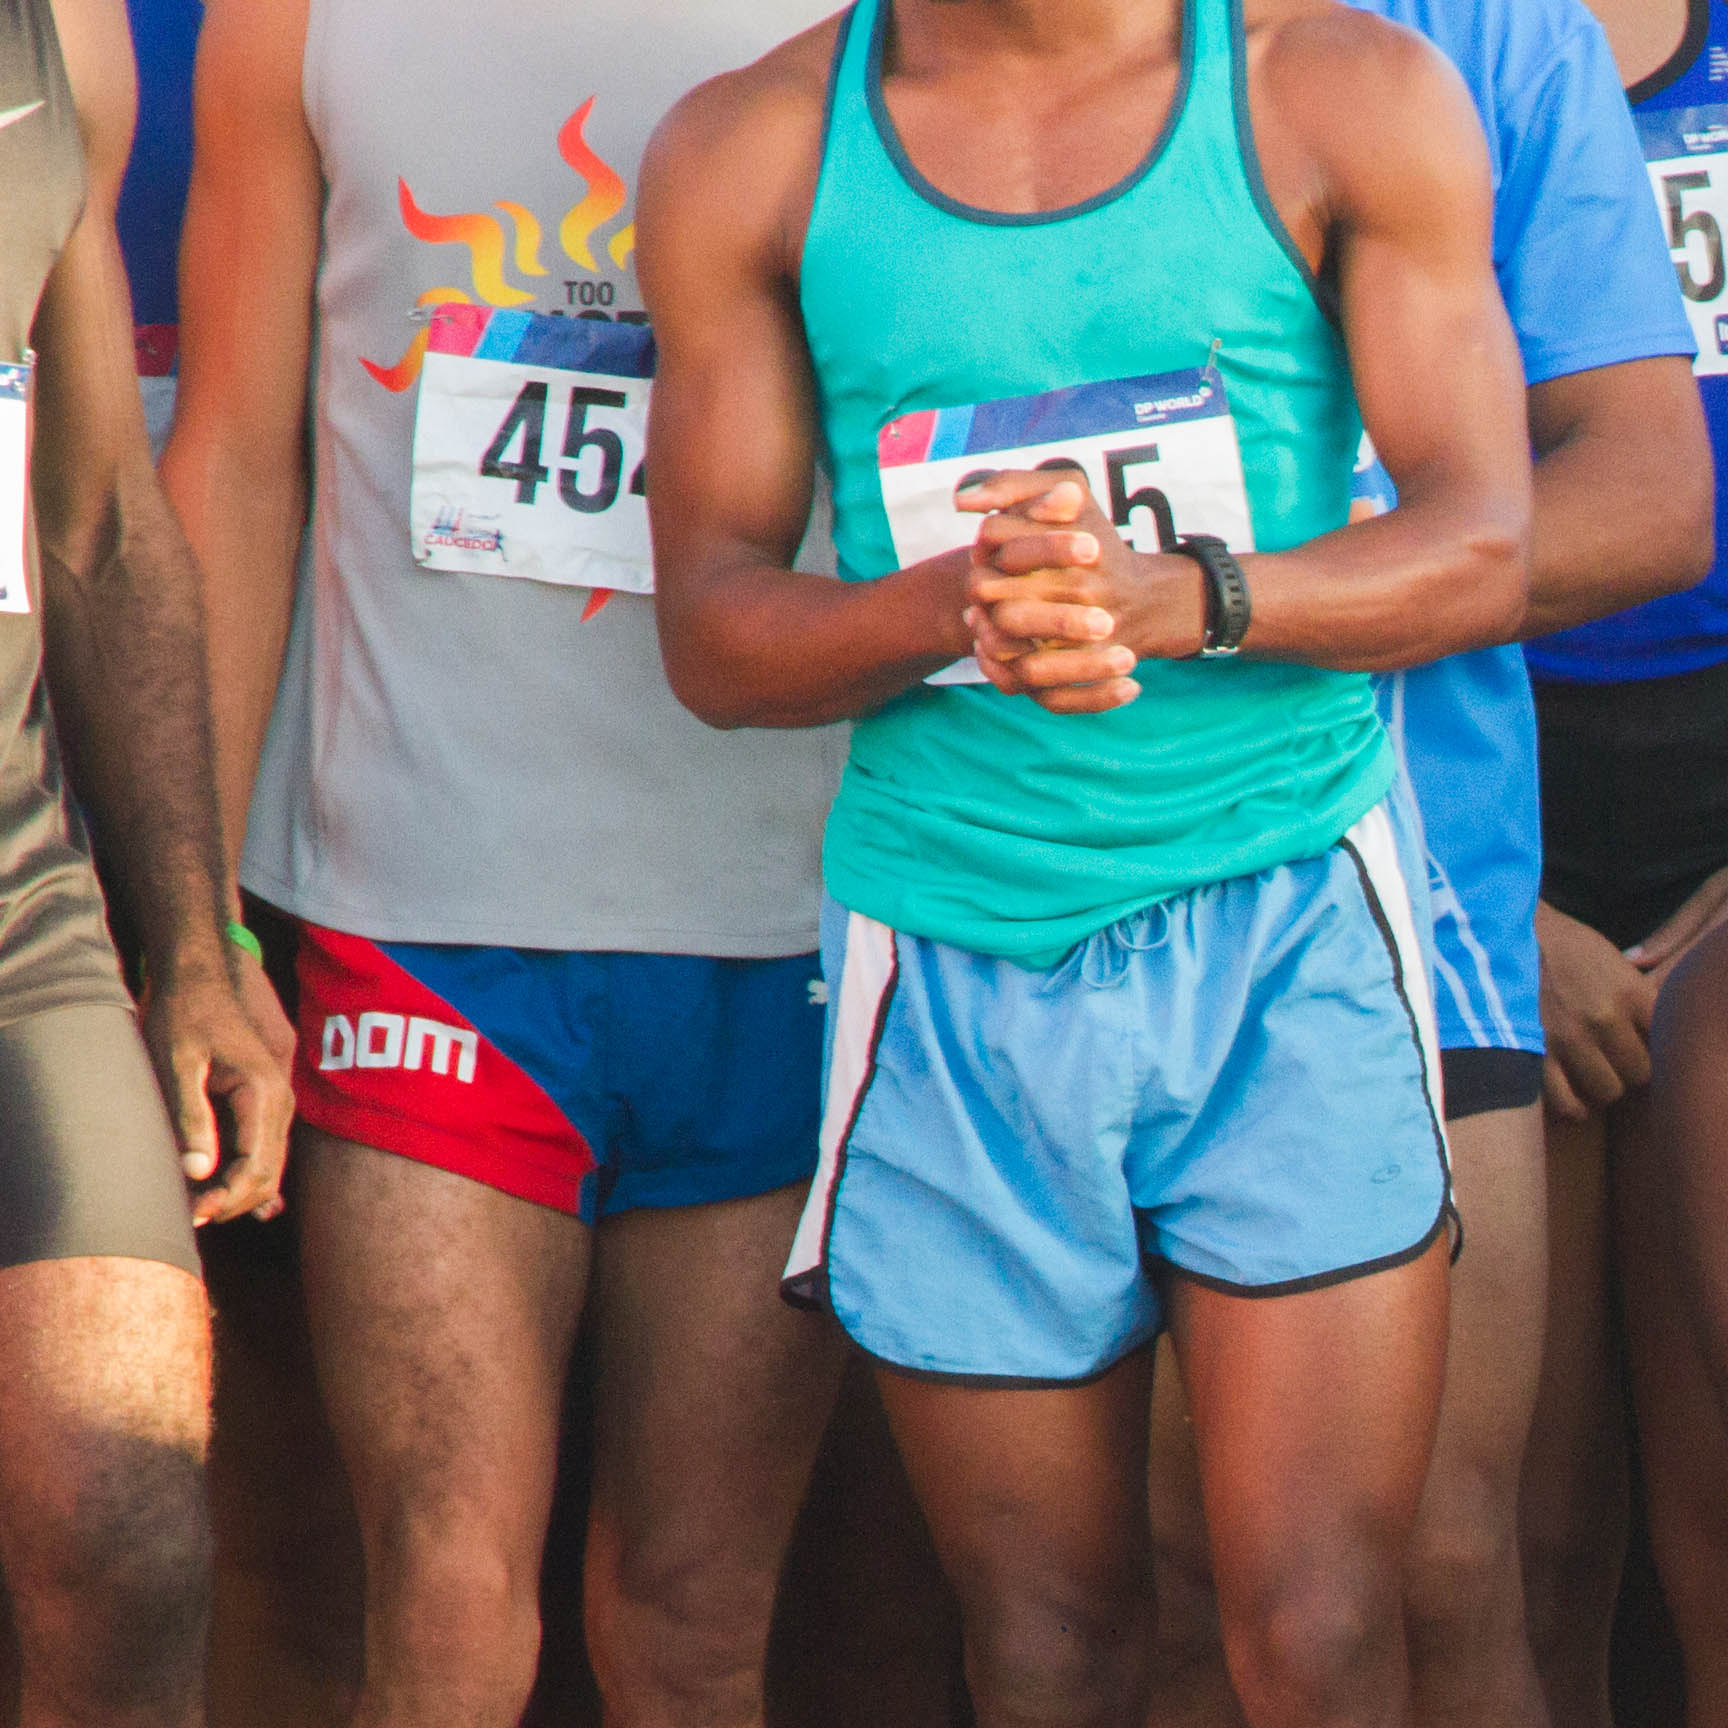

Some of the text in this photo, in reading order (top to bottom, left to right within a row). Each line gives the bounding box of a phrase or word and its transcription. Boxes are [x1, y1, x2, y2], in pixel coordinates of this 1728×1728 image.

[563, 280, 615, 306] TOO
[1134, 394, 1205, 416] DP WORLD
